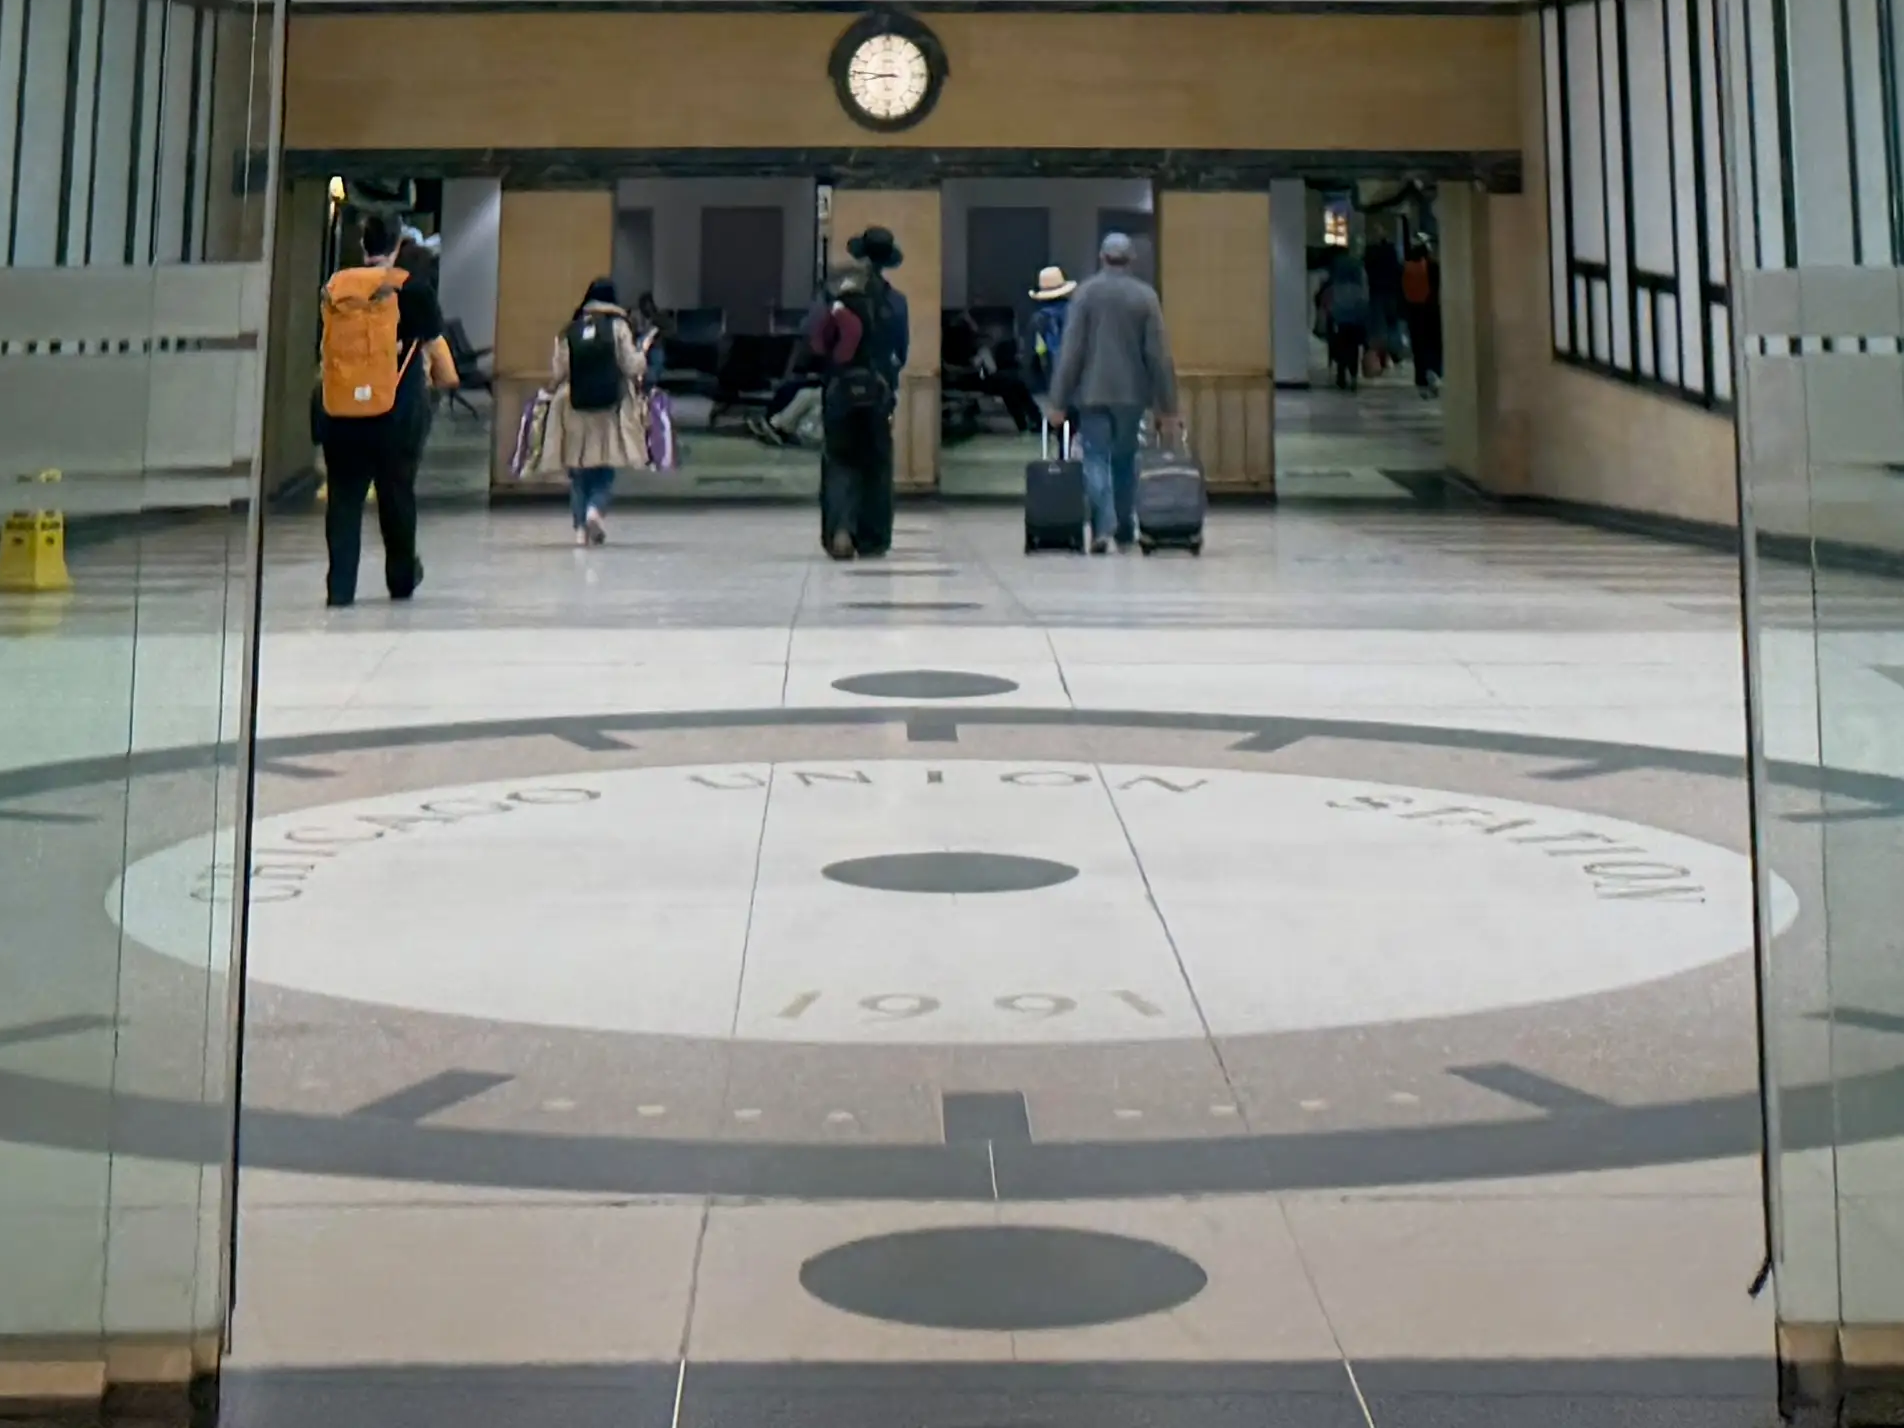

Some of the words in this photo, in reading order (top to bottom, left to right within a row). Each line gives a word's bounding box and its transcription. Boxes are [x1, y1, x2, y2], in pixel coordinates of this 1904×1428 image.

[686, 769, 1210, 793] UNION
[1324, 795, 1706, 903] STATION
[776, 990, 1166, 1022] 1991
